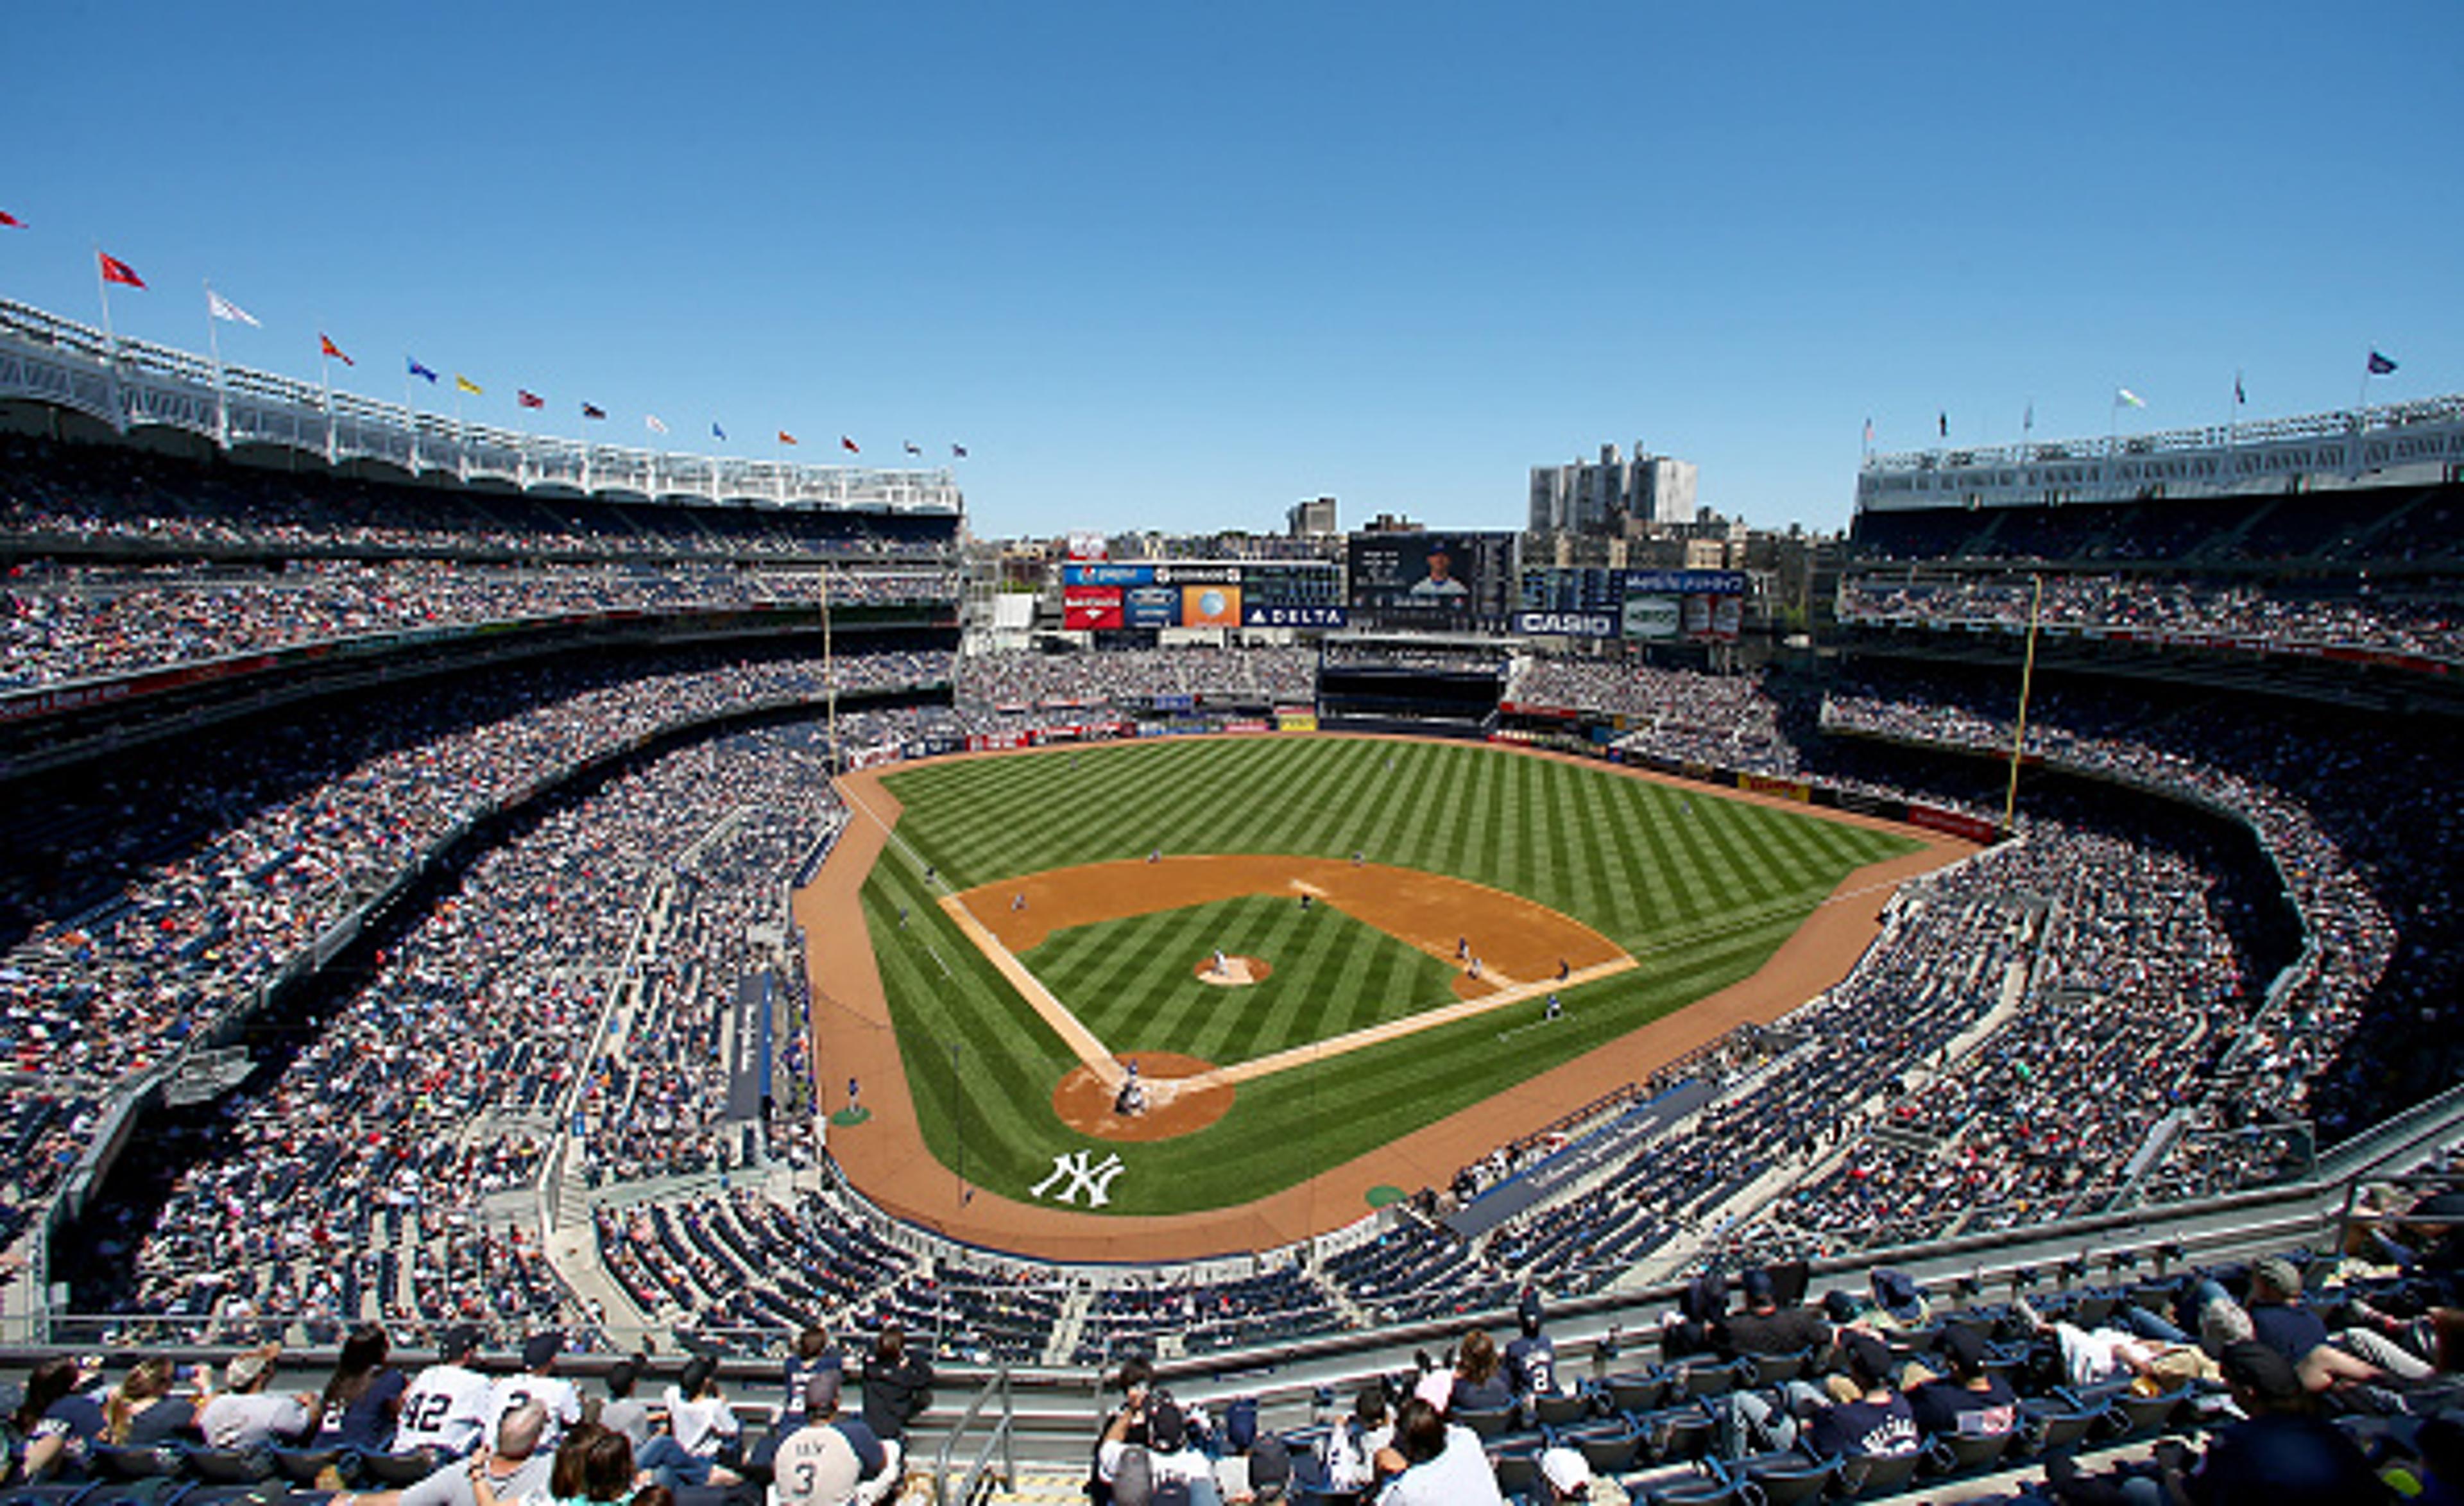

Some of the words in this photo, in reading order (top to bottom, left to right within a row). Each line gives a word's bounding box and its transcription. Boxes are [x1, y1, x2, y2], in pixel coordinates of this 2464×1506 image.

[1272, 609, 1342, 624] DELTA
[1522, 613, 1610, 636] CASIO
[1029, 1149, 1125, 1208] NY
[403, 1390, 452, 1432] 42
[792, 1463, 817, 1496] 3
